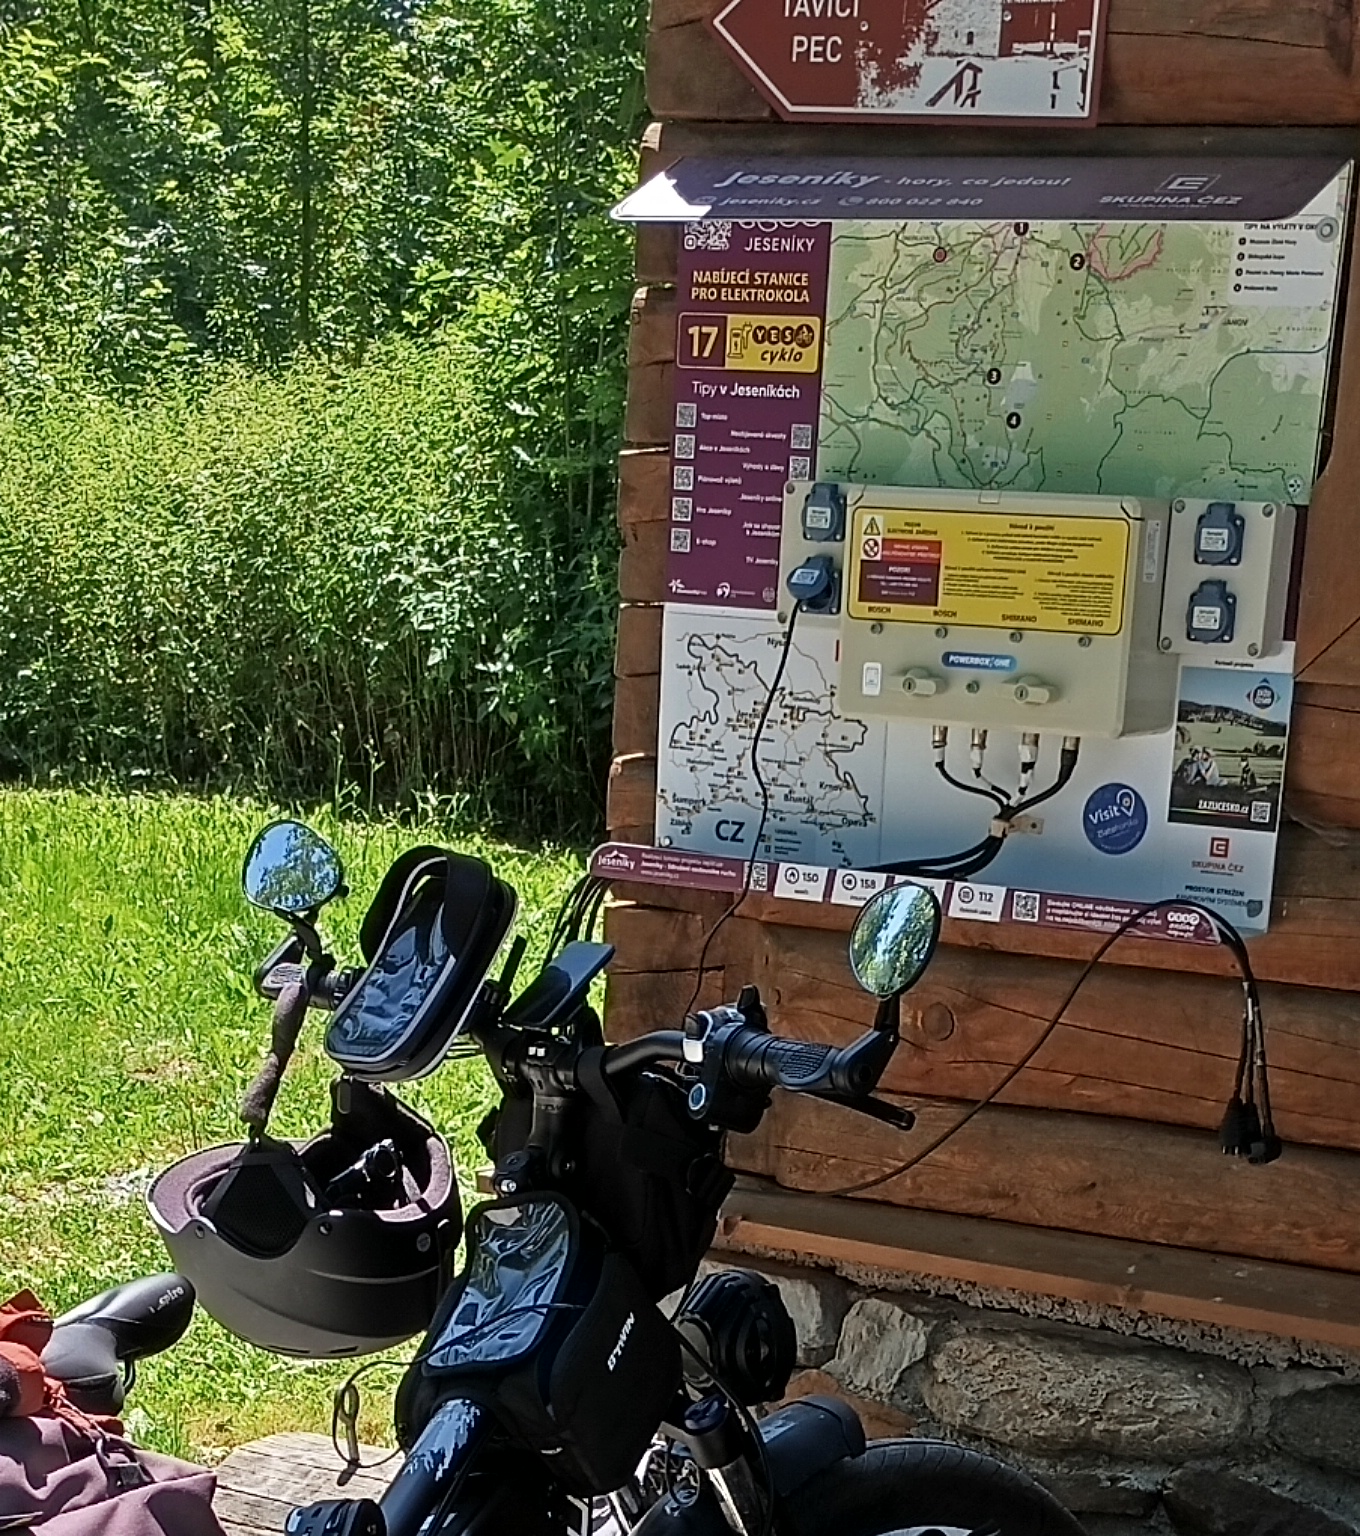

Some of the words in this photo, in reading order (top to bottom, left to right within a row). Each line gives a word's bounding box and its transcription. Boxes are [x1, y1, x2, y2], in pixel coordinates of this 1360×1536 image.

[791, 35, 843, 63] PEC
[713, 171, 883, 188] Jeseníky
[1098, 195, 1191, 205] SKUPINA
[744, 234, 815, 252] JESENÍKY
[692, 267, 750, 285] NABÍJECÍ
[753, 271, 809, 286] STANICE
[691, 287, 717, 300] PRO
[720, 288, 810, 303] ELEKTROKOLA
[688, 325, 719, 358] 17
[754, 327, 794, 344] YES
[760, 347, 803, 365] cyklo
[692, 381, 718, 398] Tipy
[720, 385, 728, 395] v
[730, 382, 800, 399] Jeseníkách
[868, 605, 892, 614] BOSCH
[933, 609, 958, 618] BOSCH
[1001, 613, 1037, 624] SHIMANO
[1068, 617, 1104, 628] SHIMANO
[1089, 805, 1122, 825] Visit
[715, 819, 746, 844] CZ
[802, 871, 819, 884] 150
[860, 878, 877, 890] 158
[978, 891, 994, 903] 112
